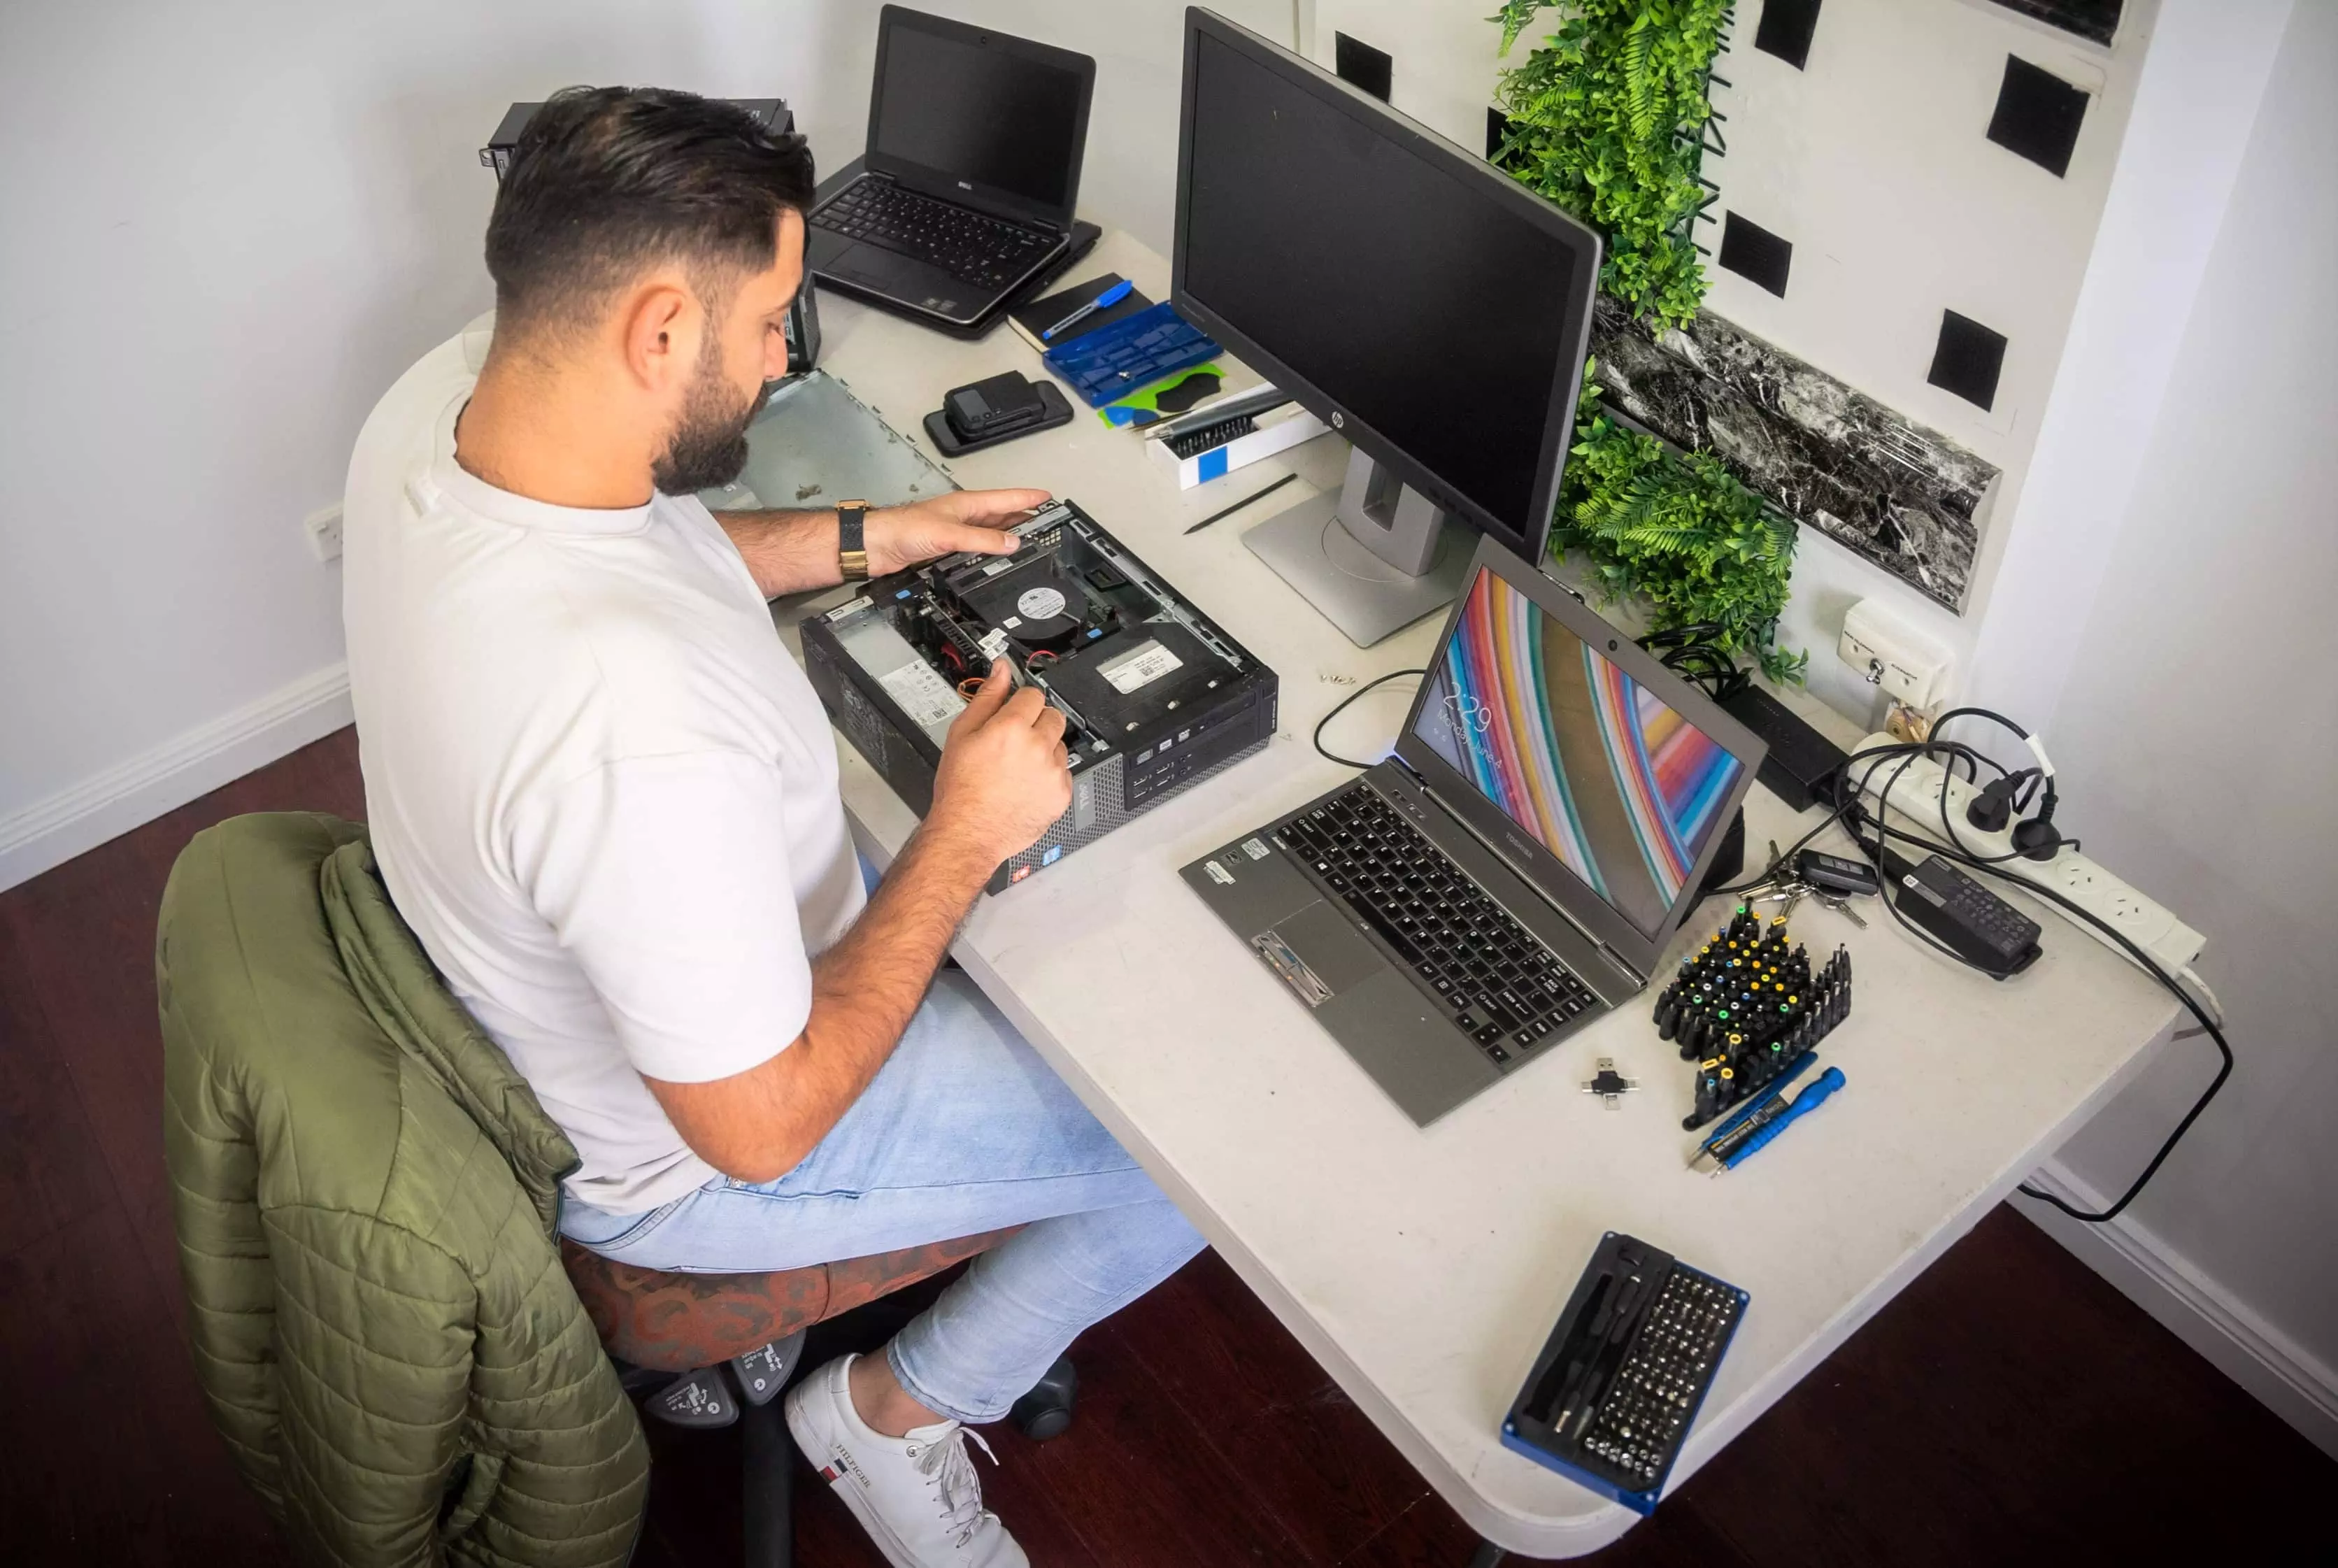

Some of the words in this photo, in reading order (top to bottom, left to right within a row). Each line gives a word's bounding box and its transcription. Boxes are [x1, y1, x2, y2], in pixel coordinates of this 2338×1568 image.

[1332, 411, 1343, 428] hp
[1443, 682, 1491, 732] 2:29
[1506, 832, 1533, 860] TOSHIBA
[836, 1444, 871, 1489] HILFIGER
